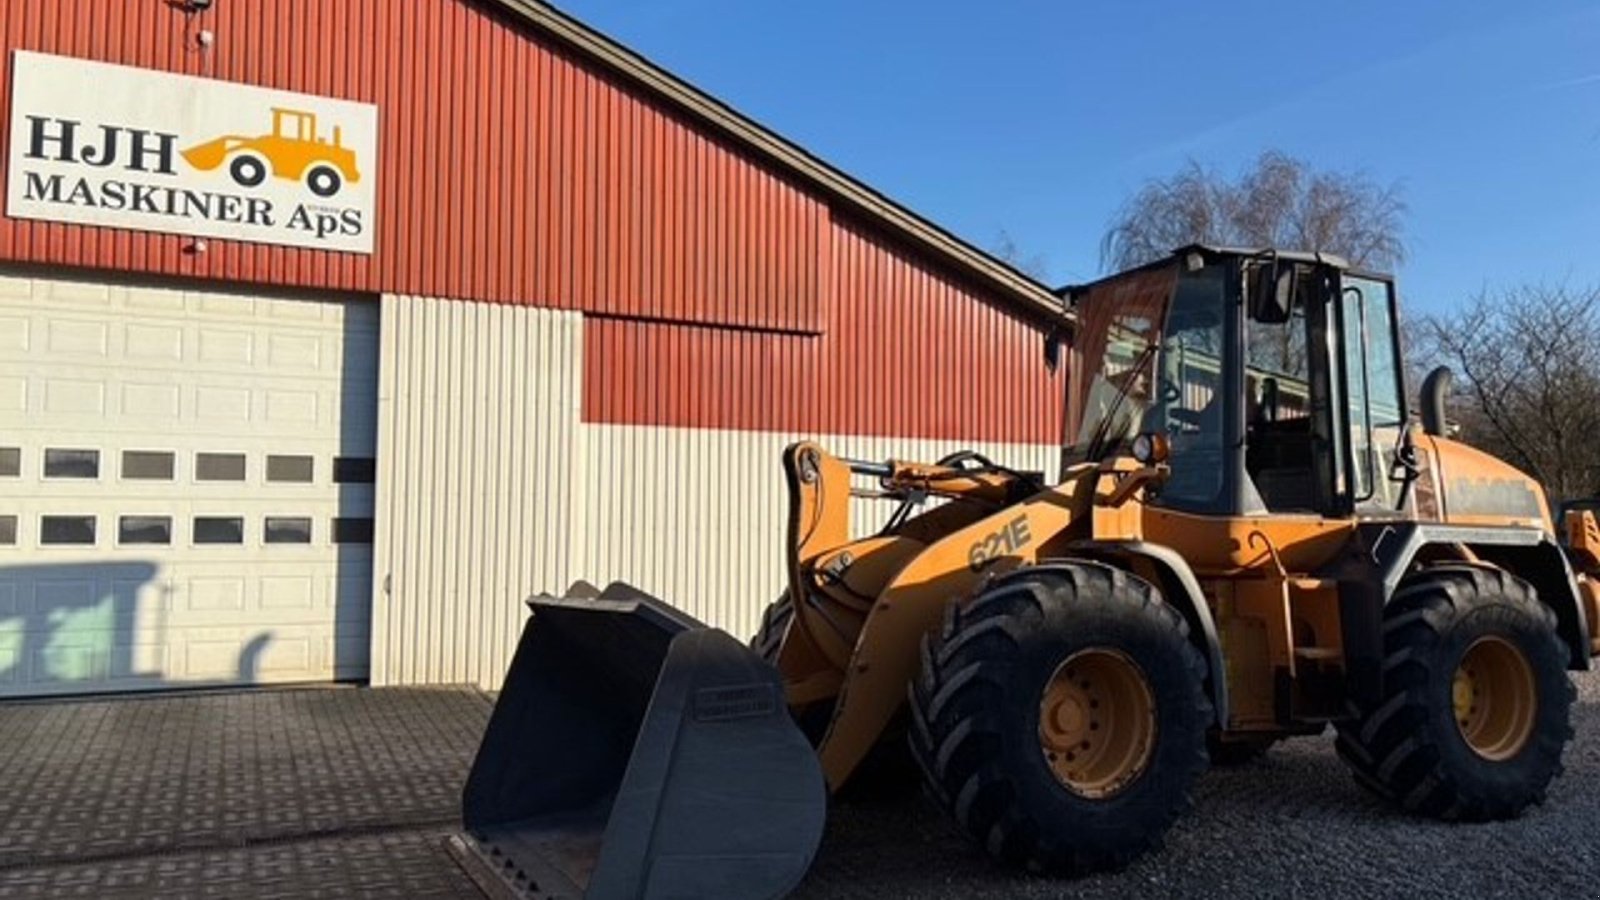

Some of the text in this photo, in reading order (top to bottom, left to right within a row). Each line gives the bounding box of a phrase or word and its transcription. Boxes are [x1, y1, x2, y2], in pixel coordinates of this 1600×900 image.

[24, 115, 179, 175] HJH
[23, 171, 363, 239] MASKINER ApS
[968, 513, 1031, 573] 621E
